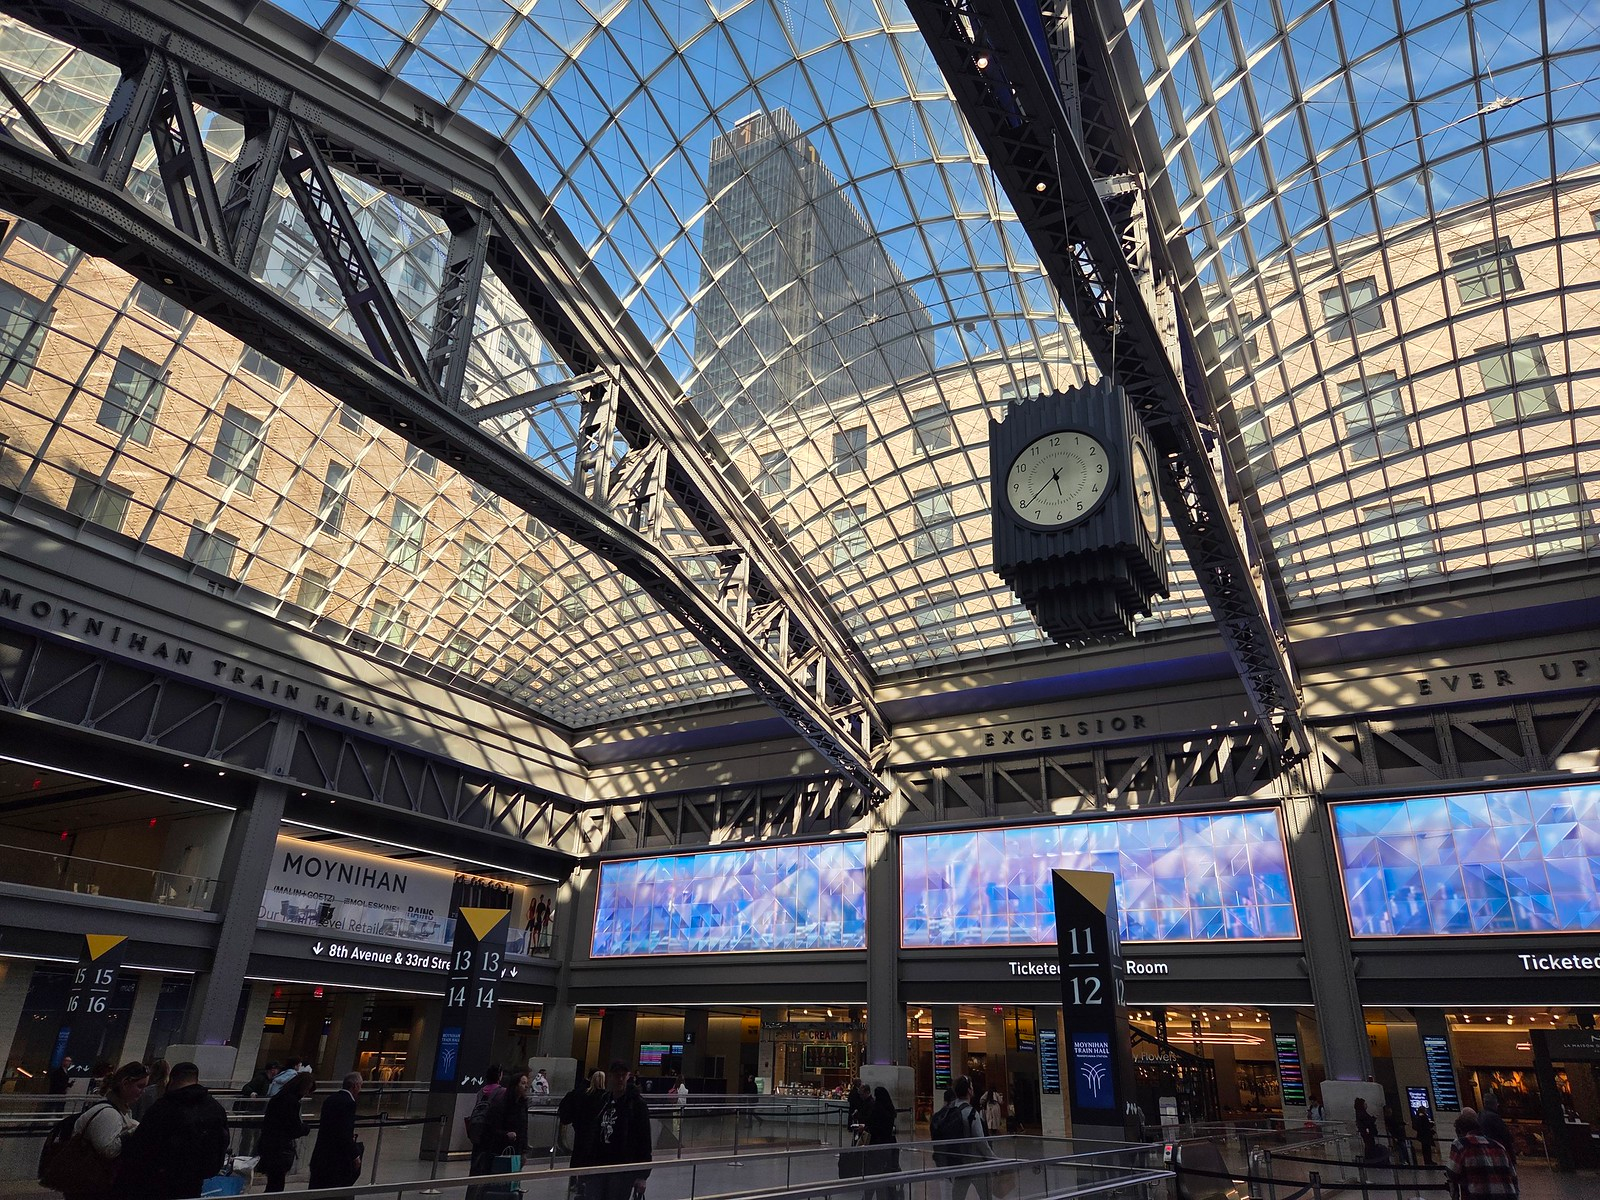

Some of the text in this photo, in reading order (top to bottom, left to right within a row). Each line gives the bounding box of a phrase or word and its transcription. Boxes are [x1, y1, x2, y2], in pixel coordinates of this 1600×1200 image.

[1049, 437, 1060, 447] 12
[1075, 437, 1079, 445] 1
[1031, 447, 1040, 456] 11
[1089, 447, 1096, 456] 2
[1016, 464, 1027, 473] 10
[1096, 464, 1103, 473] 3
[1013, 483, 1020, 492] 9
[1092, 484, 1098, 493] 4
[1020, 500, 1026, 509] 8
[1077, 501, 1083, 511] 5
[1035, 510, 1041, 519] 7
[1057, 511, 1063, 520] 6
[0, 588, 375, 726] MOYNIHAN TRAIN HALL
[1417, 657, 1600, 696] EVER UP
[984, 715, 1147, 747] EXCELSIOR
[283, 852, 407, 894] MOYNIHAN
[1068, 927, 1095, 955] 11
[1111, 929, 1121, 957] 11
[328, 944, 450, 971] 8th Avenue & 33rd Stre
[454, 950, 471, 971] 13
[482, 951, 500, 972] 13
[1126, 960, 1168, 974] Room
[75, 968, 87, 984] 15
[94, 969, 113, 985] 15
[448, 986, 465, 1007] 14
[476, 987, 494, 1009] 14
[1070, 976, 1102, 1005] 12
[1115, 977, 1126, 1007] 12
[67, 995, 80, 1012] 16
[87, 997, 108, 1013] 16
[808, 1030, 839, 1040] CREAM
[1093, 1047, 1110, 1055] HALL
[1141, 1051, 1177, 1062] Flowers
